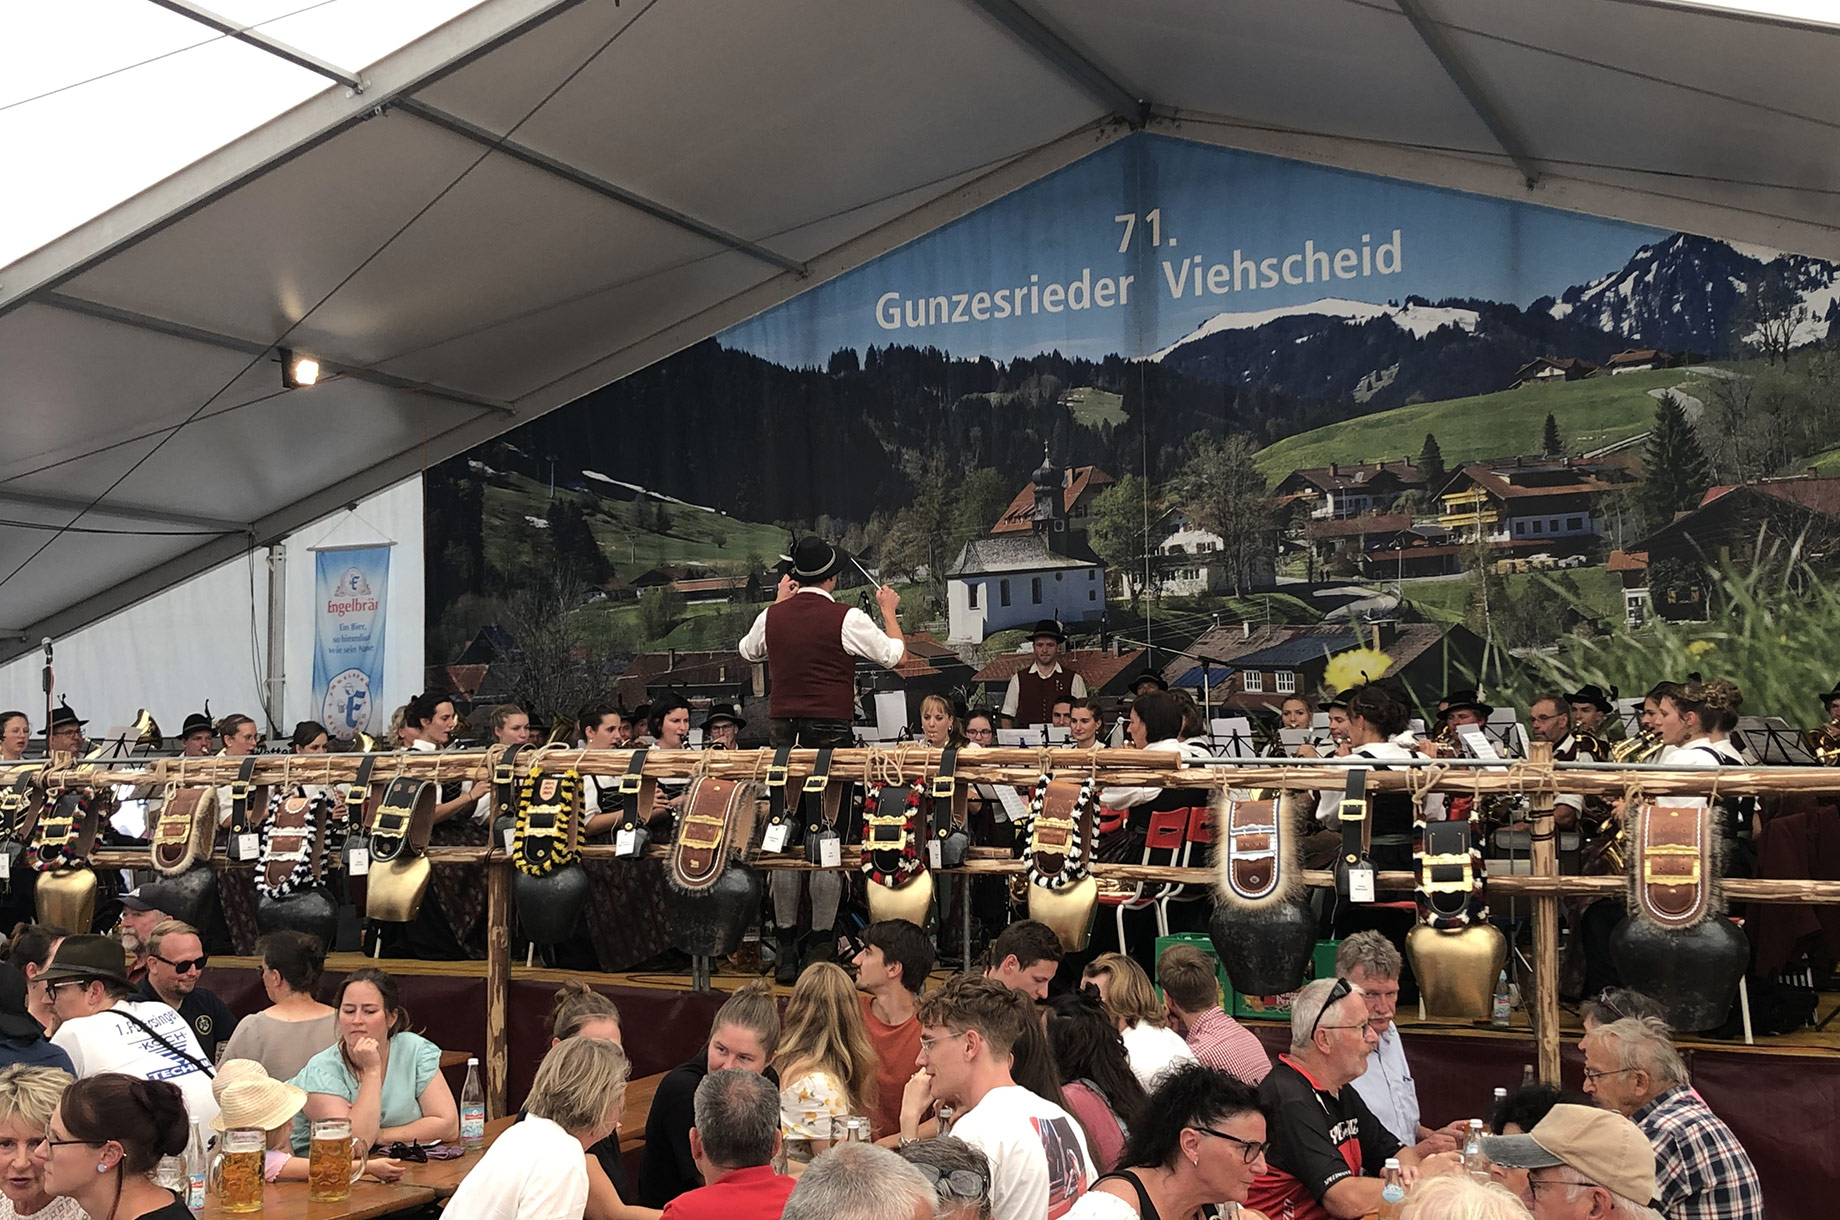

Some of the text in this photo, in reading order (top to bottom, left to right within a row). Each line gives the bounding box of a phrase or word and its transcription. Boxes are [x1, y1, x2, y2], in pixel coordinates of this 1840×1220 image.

[1113, 207, 1178, 254] 71.
[875, 229, 1403, 330] Gunzesrieder Viehscheid
